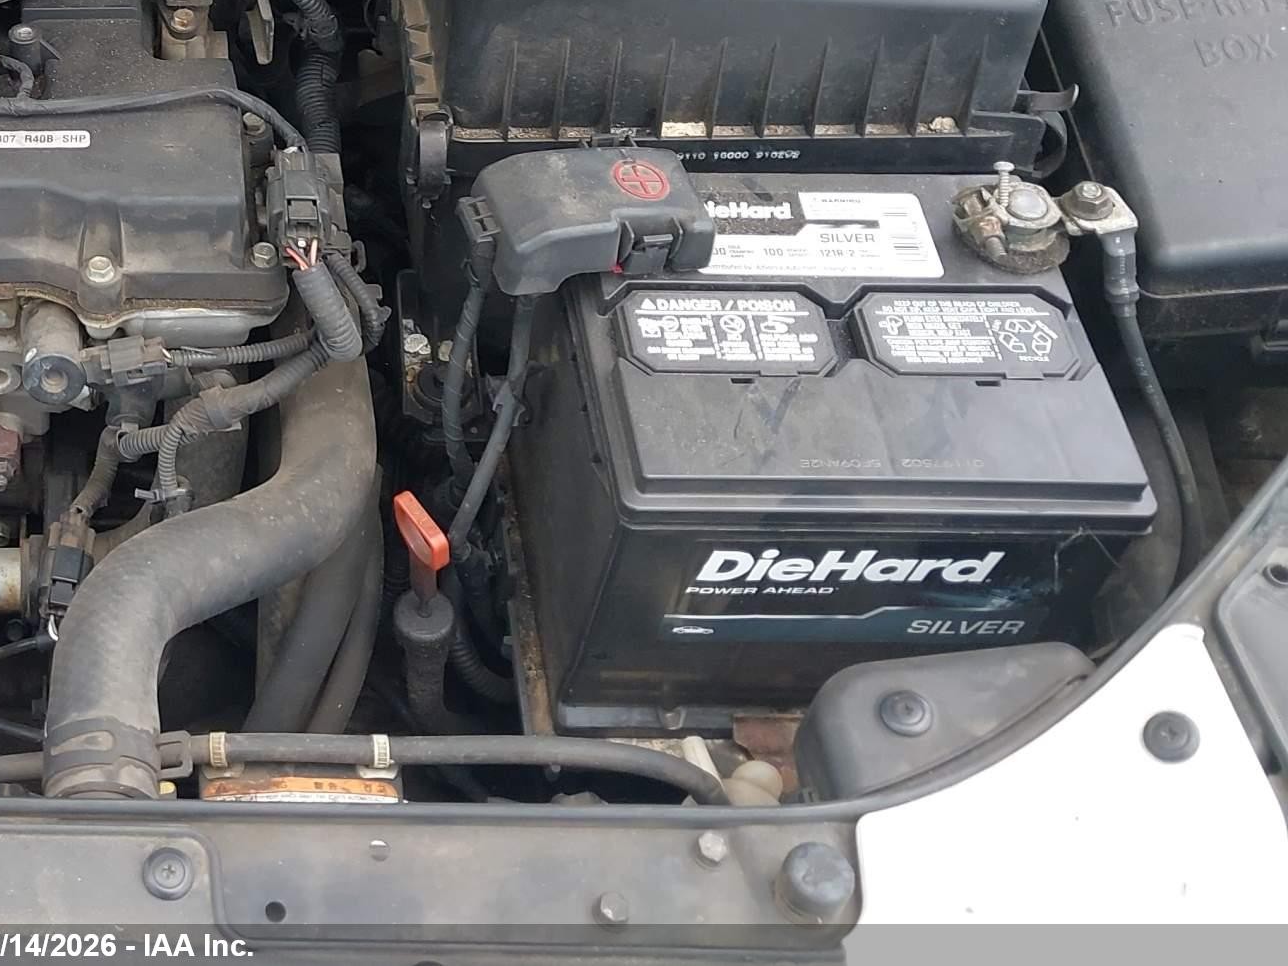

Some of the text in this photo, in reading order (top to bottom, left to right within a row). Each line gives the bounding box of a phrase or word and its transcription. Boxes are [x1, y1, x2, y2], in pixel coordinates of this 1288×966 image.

[1193, 34, 1278, 68] BOX
[820, 233, 875, 243] SILVER
[655, 298, 722, 311] DANGER
[737, 299, 797, 312] POISON
[695, 548, 1006, 583] DieHard
[685, 585, 836, 595] POWER AHEAD
[906, 619, 1026, 635] SILVER
